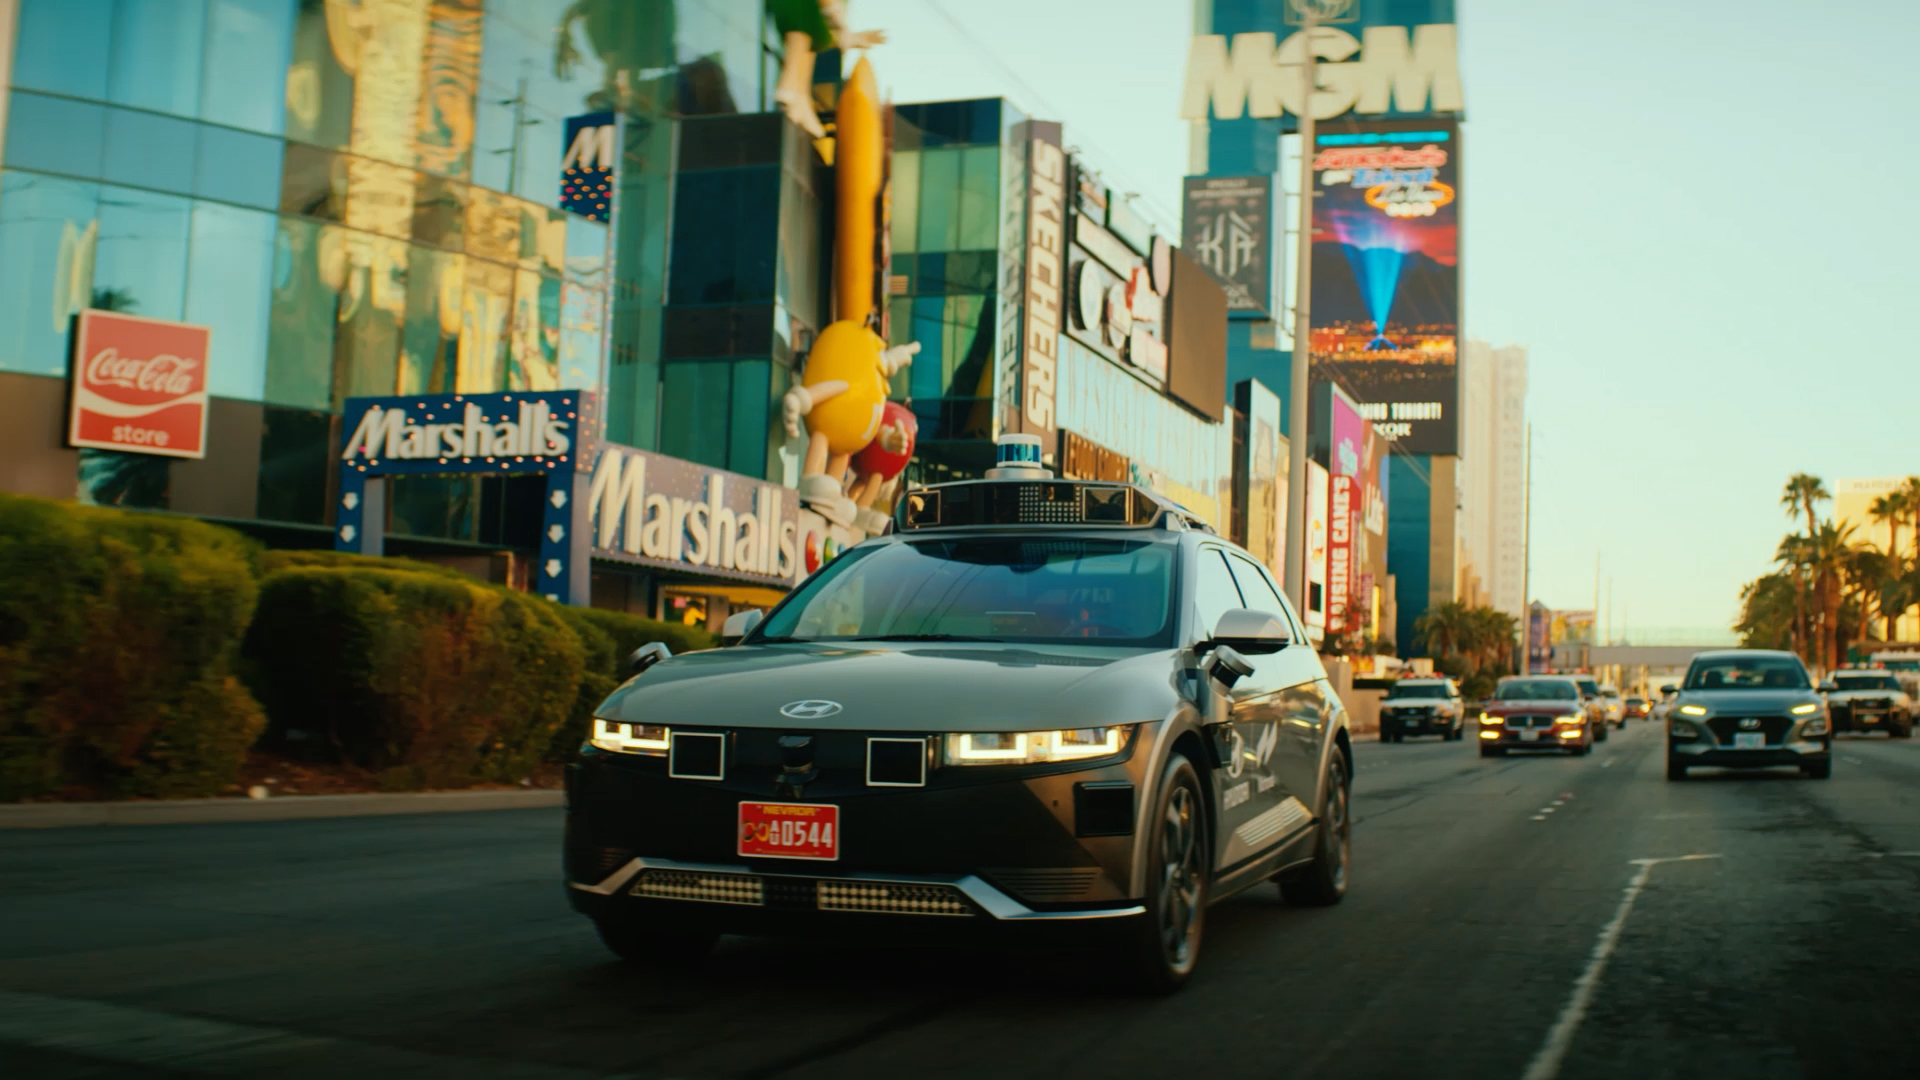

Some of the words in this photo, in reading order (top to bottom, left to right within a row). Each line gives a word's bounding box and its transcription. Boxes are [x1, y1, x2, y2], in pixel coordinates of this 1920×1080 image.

[1181, 23, 1464, 120] MGM
[1024, 138, 1063, 433] SKECHERS
[112, 424, 170, 446] store
[342, 402, 570, 461] Marshalls
[588, 447, 796, 580] Marshalls
